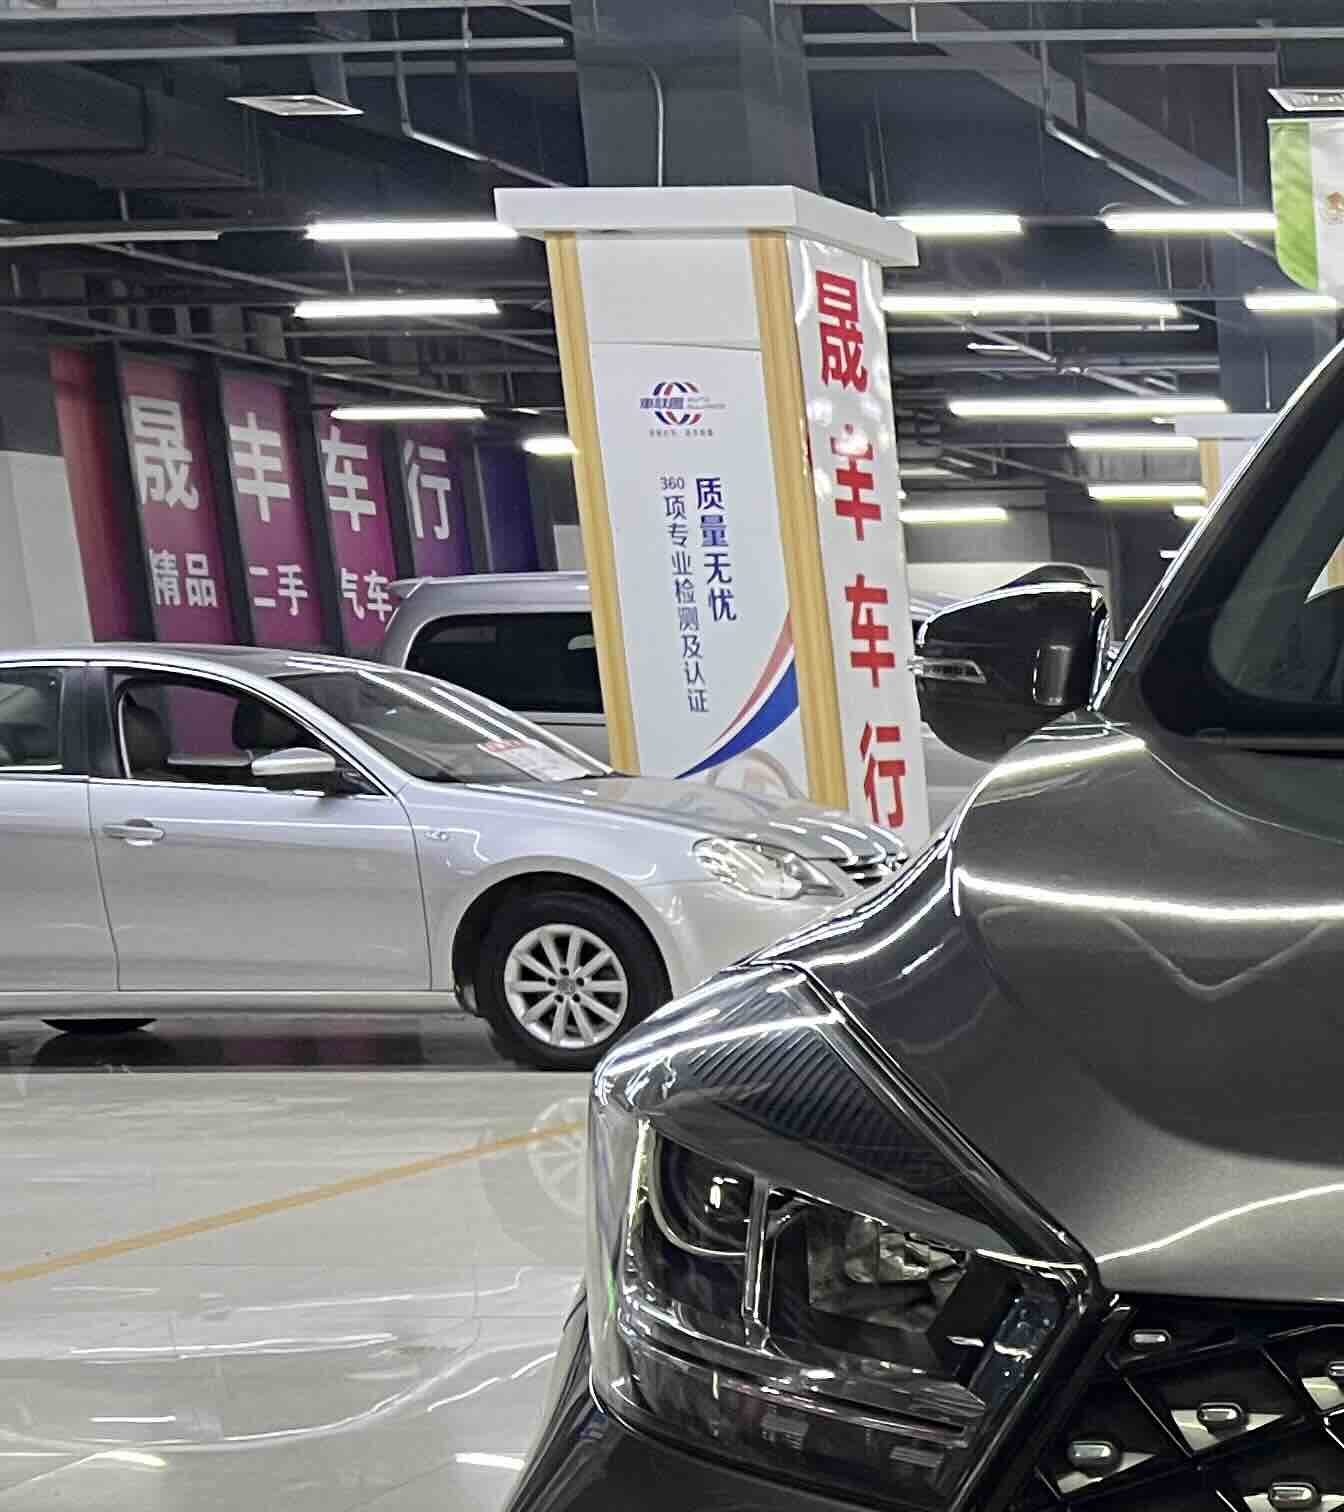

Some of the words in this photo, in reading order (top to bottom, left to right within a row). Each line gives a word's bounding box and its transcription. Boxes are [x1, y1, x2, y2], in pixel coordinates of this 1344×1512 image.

[249, 564, 308, 616] 二手
[696, 477, 737, 622] 质量无忧
